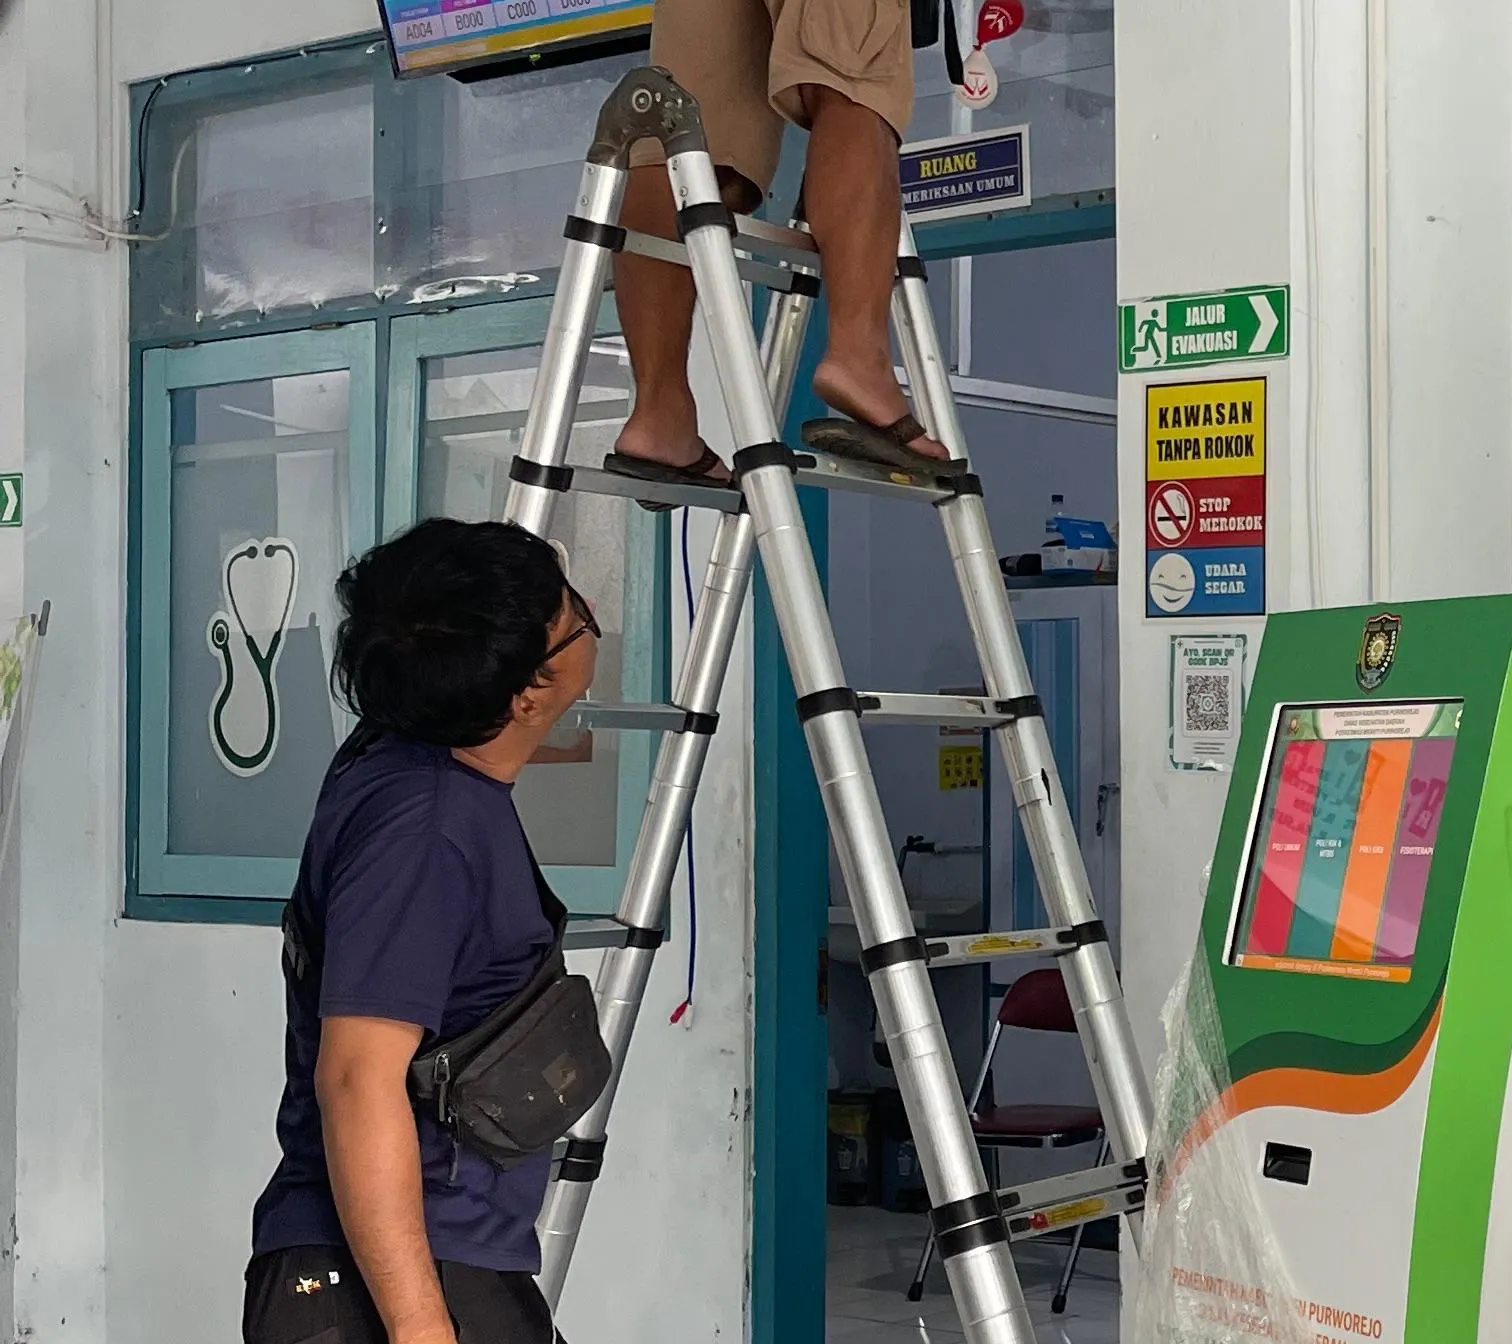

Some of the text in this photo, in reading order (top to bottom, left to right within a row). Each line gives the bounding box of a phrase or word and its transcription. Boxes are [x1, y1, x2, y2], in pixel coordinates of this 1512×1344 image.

[507, 0, 537, 20] C000
[406, 21, 433, 41] A004
[455, 11, 484, 31] B000
[920, 152, 977, 178] RUANG
[902, 175, 1015, 204] MERIKSAAN UMUM
[1185, 304, 1226, 327] JALUR
[1171, 330, 1238, 356] EVAKUASI
[1158, 401, 1253, 429] KAWASAN
[1156, 434, 1255, 462] TANPA ROKOK
[1199, 497, 1231, 513] STOP
[1199, 516, 1263, 533] MEROKOK
[1205, 563, 1247, 577] UDARA
[1204, 581, 1246, 595] SEGAR
[1202, 648, 1222, 657] SCAN
[1308, 1302, 1382, 1339] PURWOREJO
